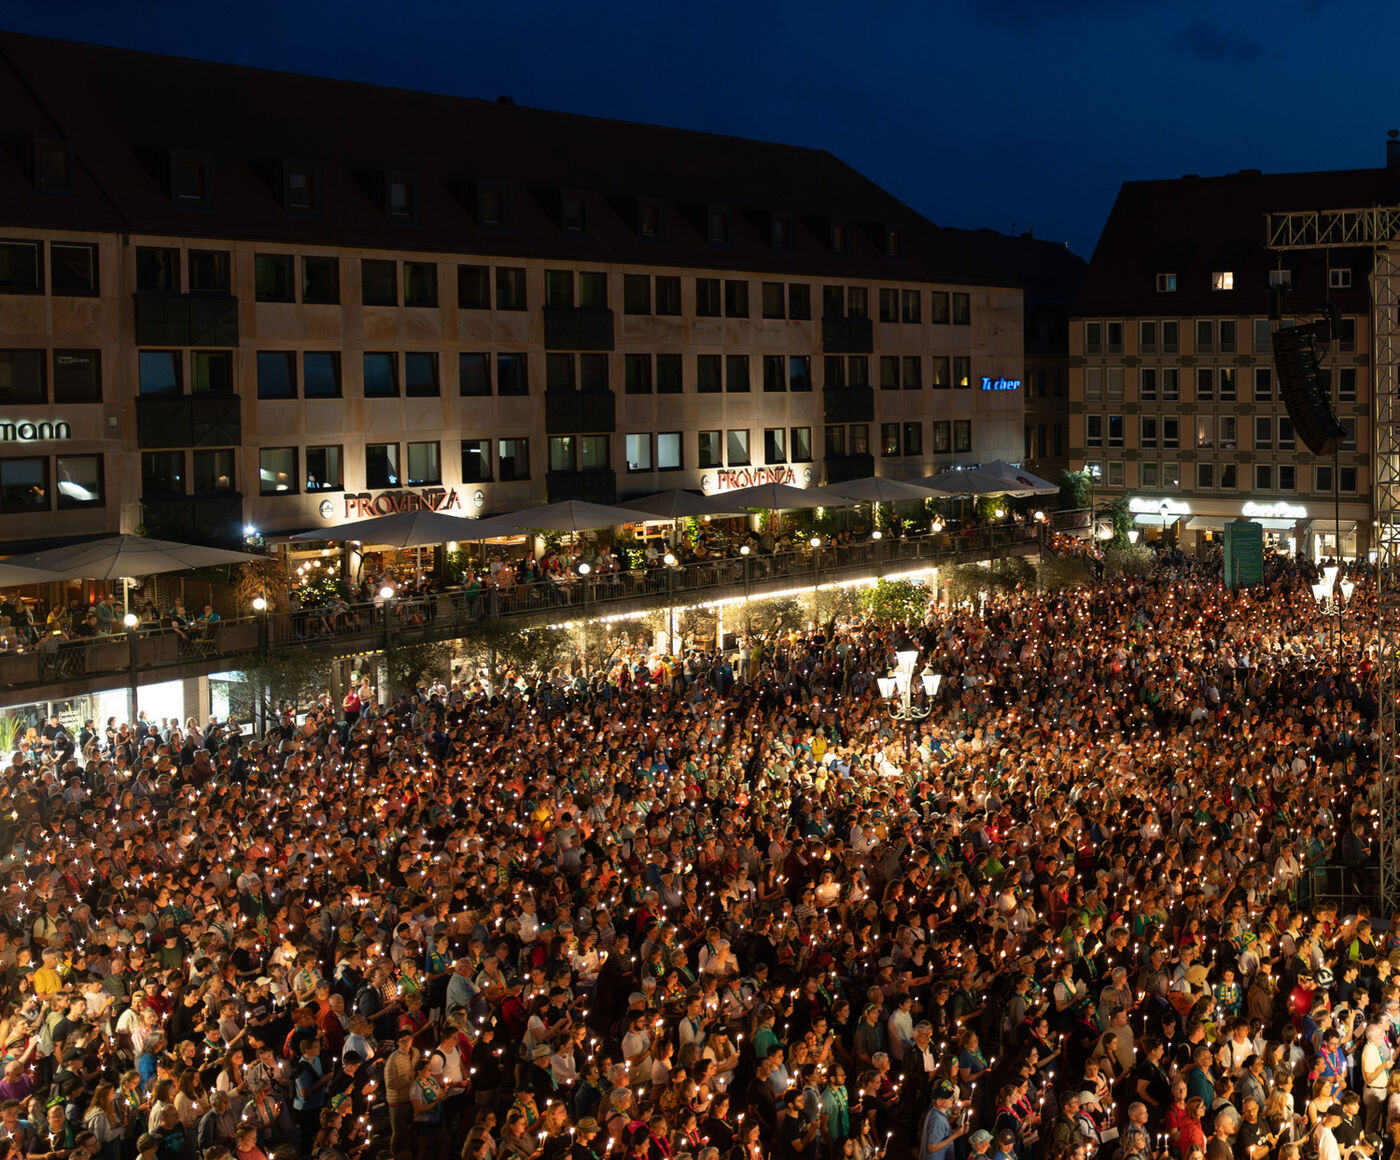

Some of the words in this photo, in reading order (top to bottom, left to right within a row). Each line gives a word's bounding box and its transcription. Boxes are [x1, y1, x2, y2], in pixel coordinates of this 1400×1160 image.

[0, 421, 72, 441] mann
[718, 468, 797, 489] PROVENZA
[344, 490, 463, 518] PROVENZA
